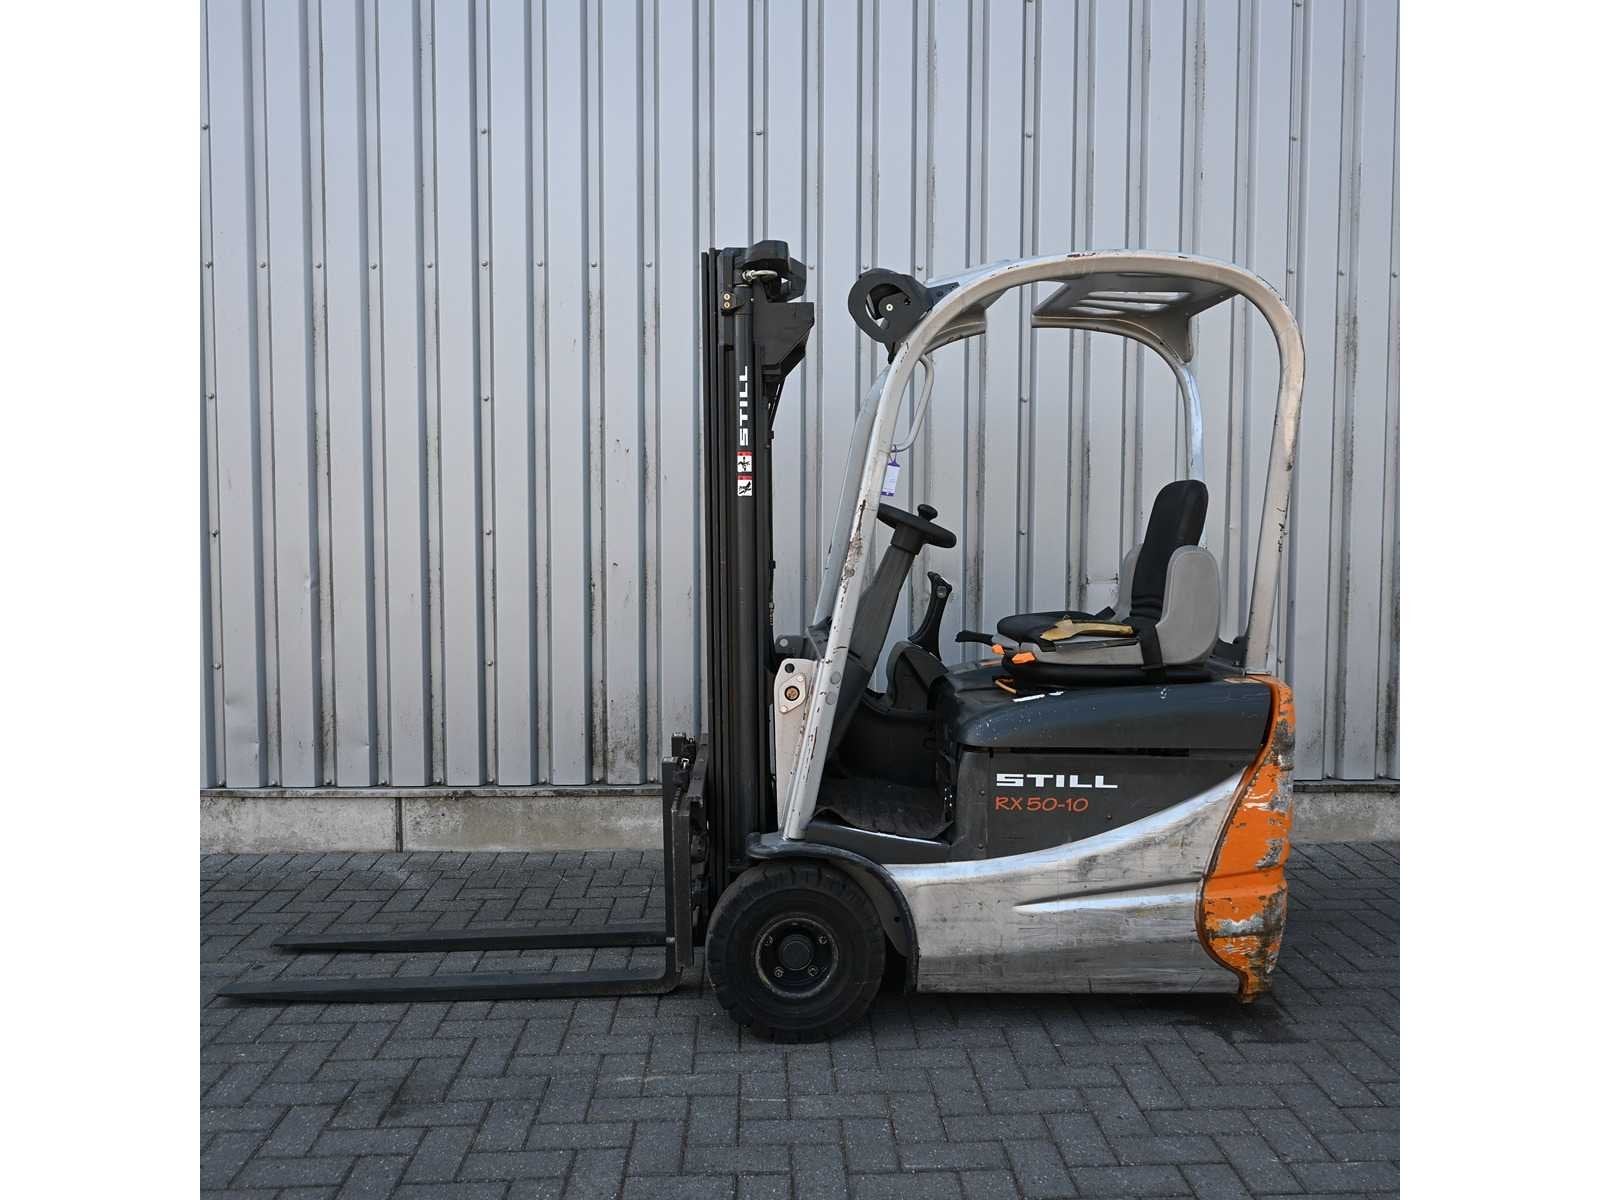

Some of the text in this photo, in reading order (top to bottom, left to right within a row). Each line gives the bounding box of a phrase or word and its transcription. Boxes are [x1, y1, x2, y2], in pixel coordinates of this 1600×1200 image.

[739, 365, 749, 447] STILL
[996, 773, 1118, 789] STILL
[995, 796, 1089, 813] RX 50-10
